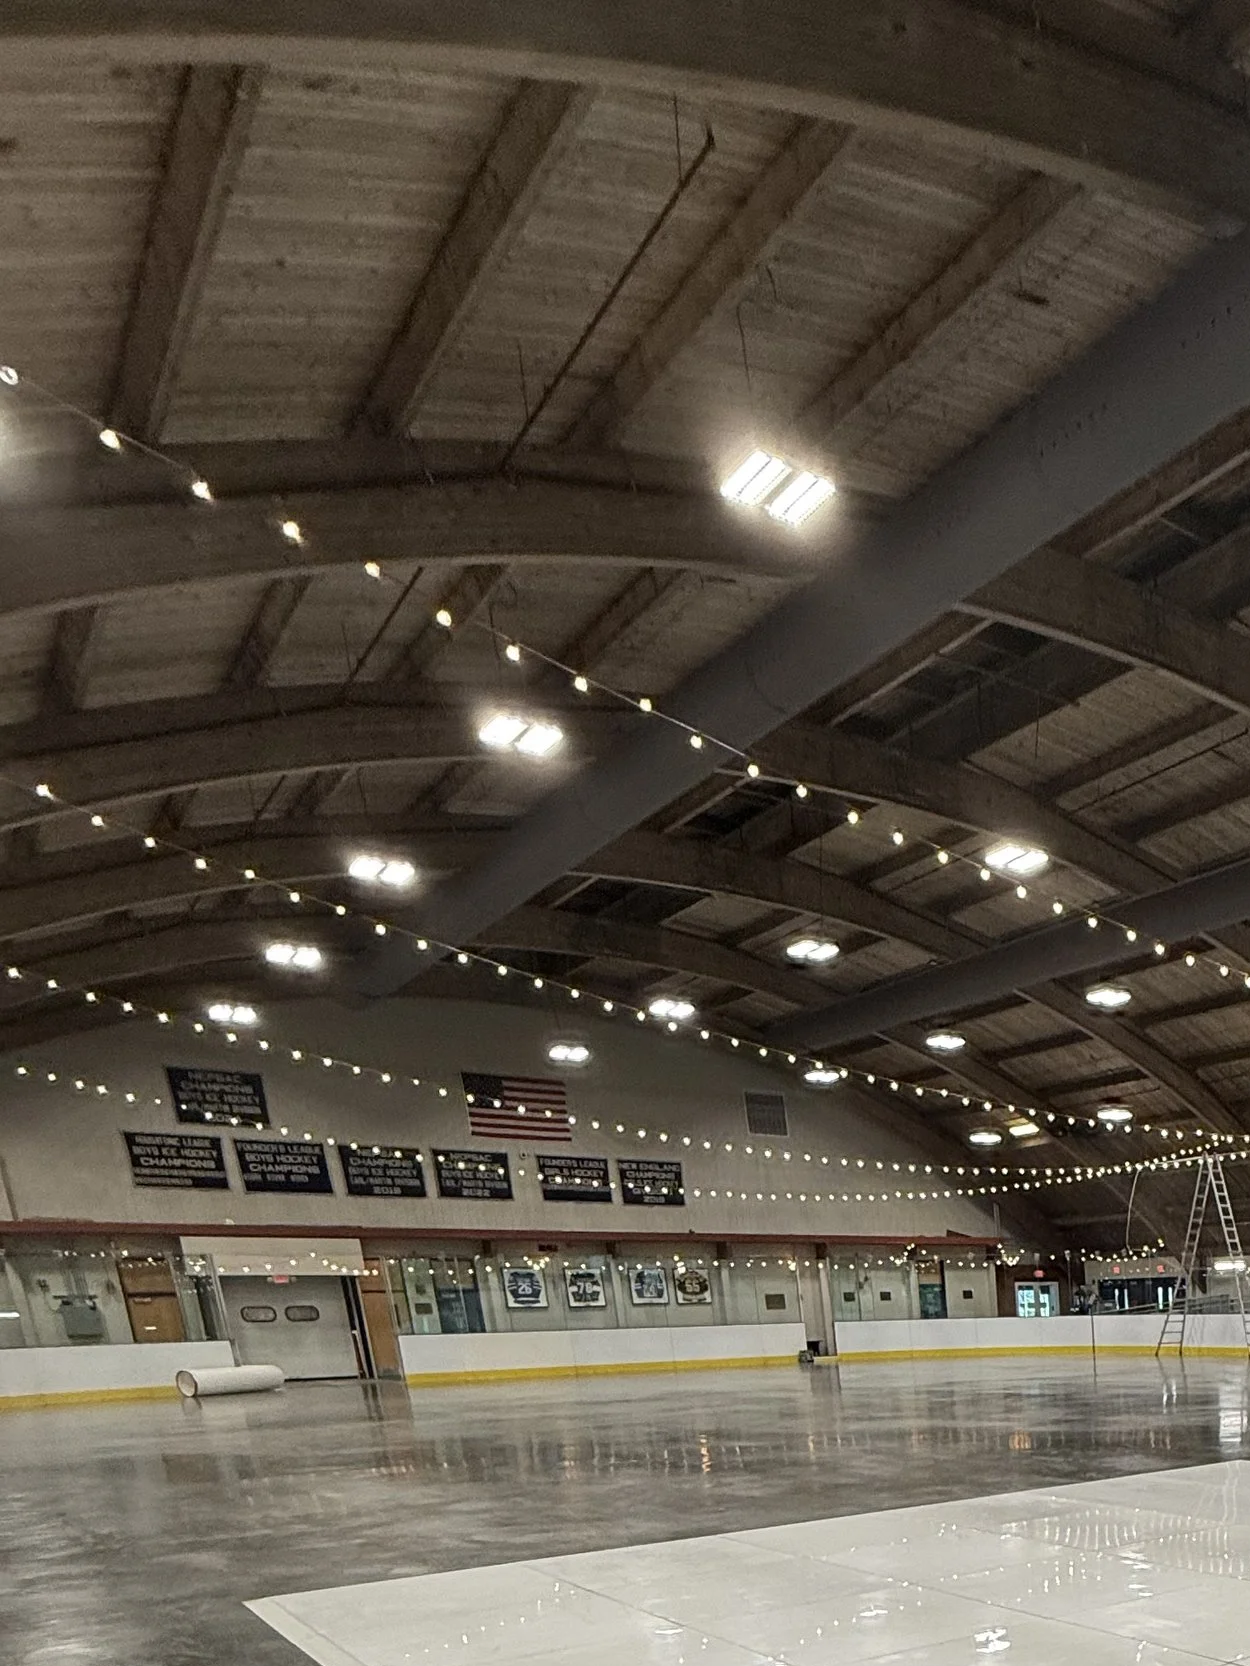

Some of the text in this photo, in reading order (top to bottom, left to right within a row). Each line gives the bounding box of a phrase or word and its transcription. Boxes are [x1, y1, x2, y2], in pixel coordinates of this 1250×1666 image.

[180, 1148, 217, 1158] HOCKEY
[140, 1156, 217, 1169] CHAMPIONS
[275, 1154, 318, 1164] HOCKEY
[249, 1163, 321, 1174] CHAMPIONS
[571, 1169, 605, 1178] HOCKEY
[518, 1282, 532, 1295] 26
